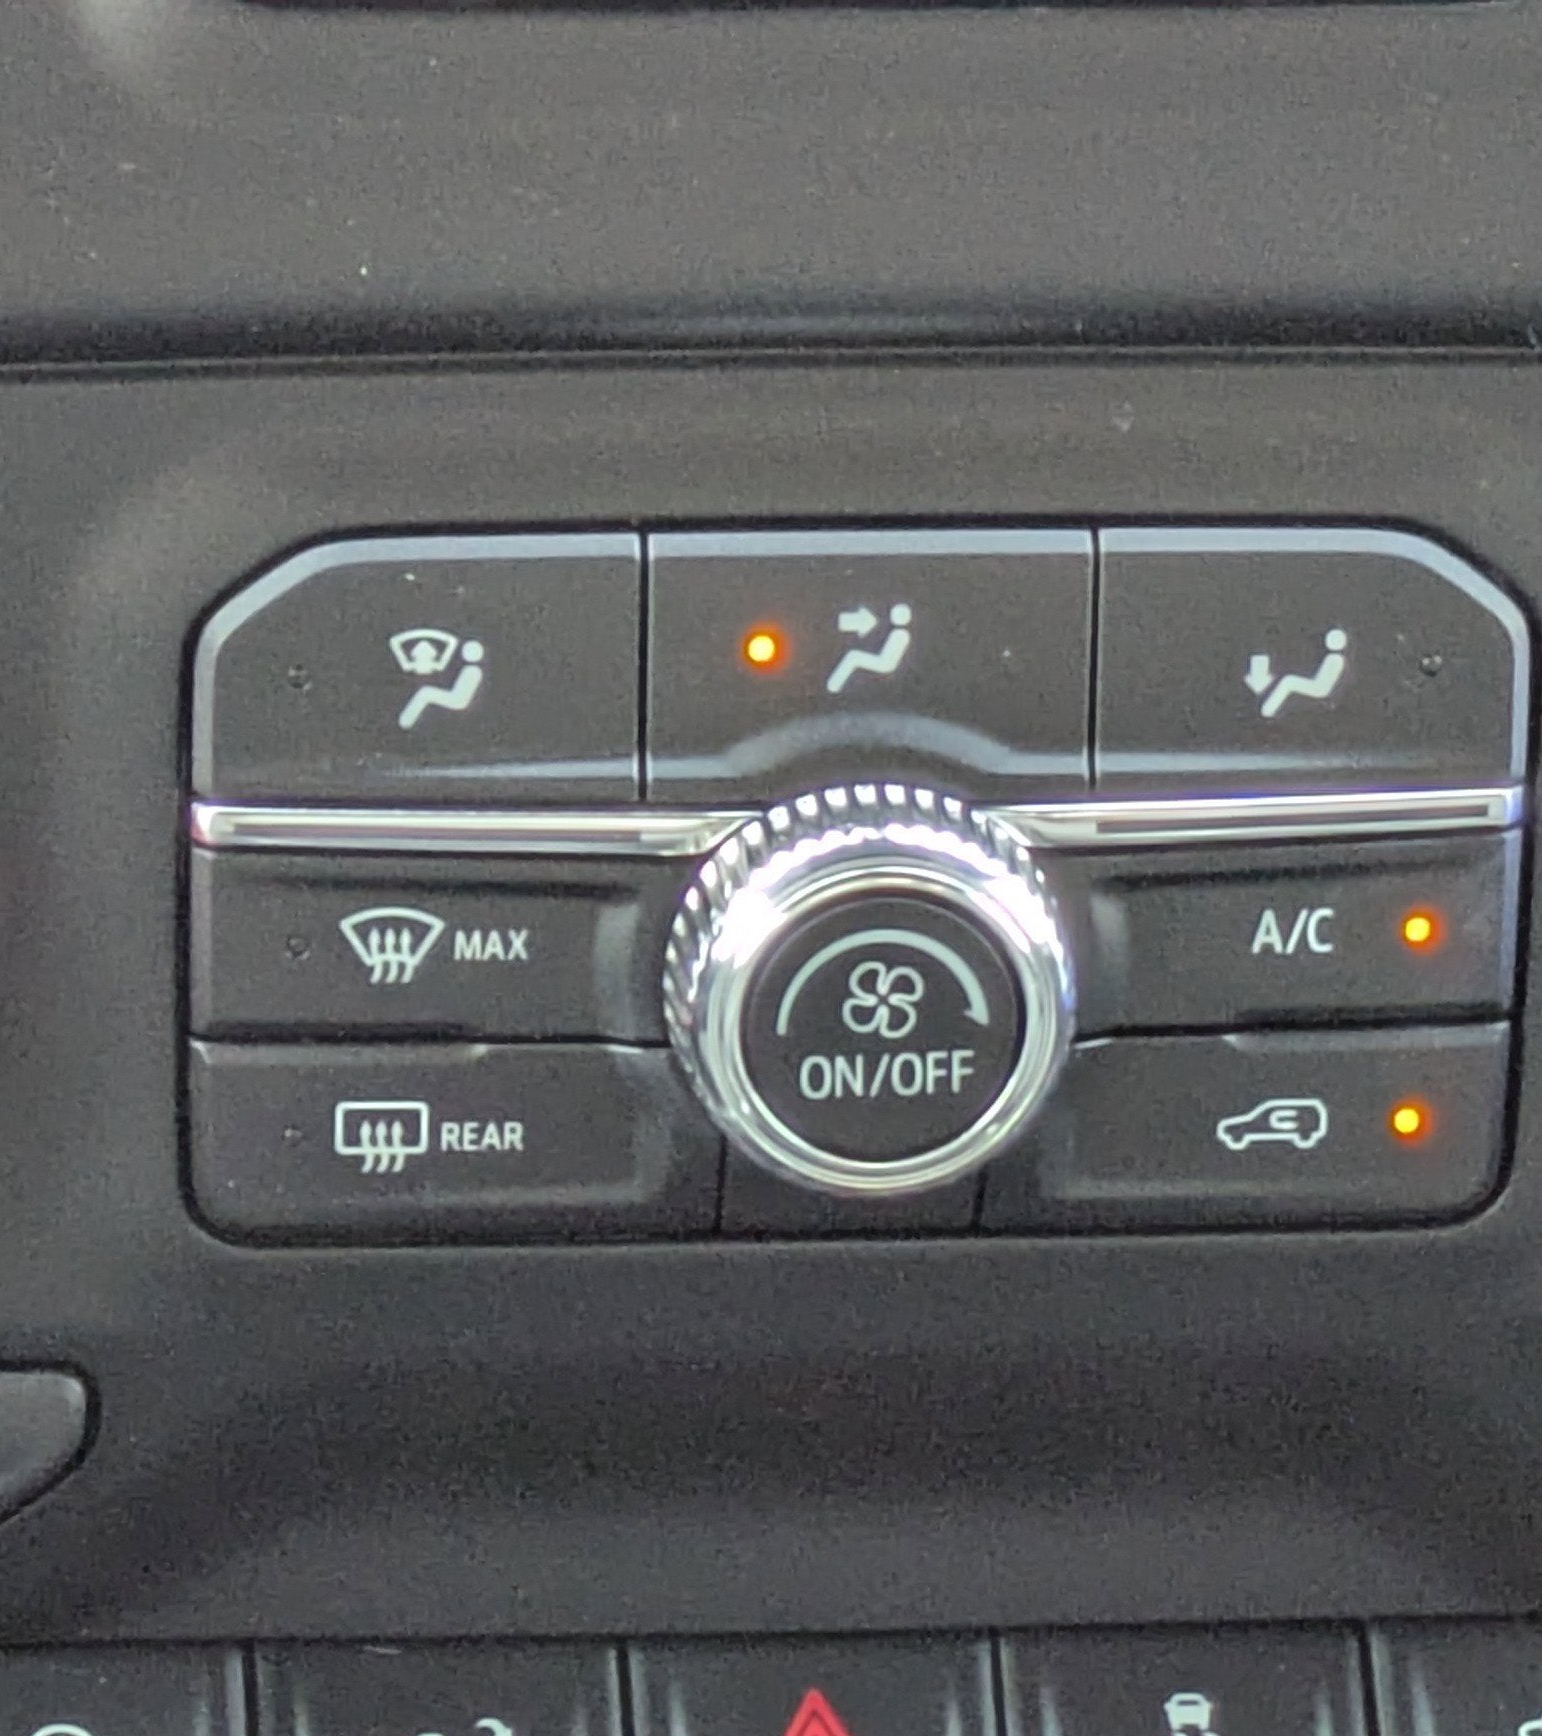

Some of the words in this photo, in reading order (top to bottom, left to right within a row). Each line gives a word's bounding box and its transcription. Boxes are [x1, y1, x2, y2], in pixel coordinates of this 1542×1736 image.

[454, 929, 530, 962] MAX
[1252, 907, 1336, 956] A/C
[799, 1049, 976, 1101] ON/OFF
[440, 1121, 525, 1153] REAR
